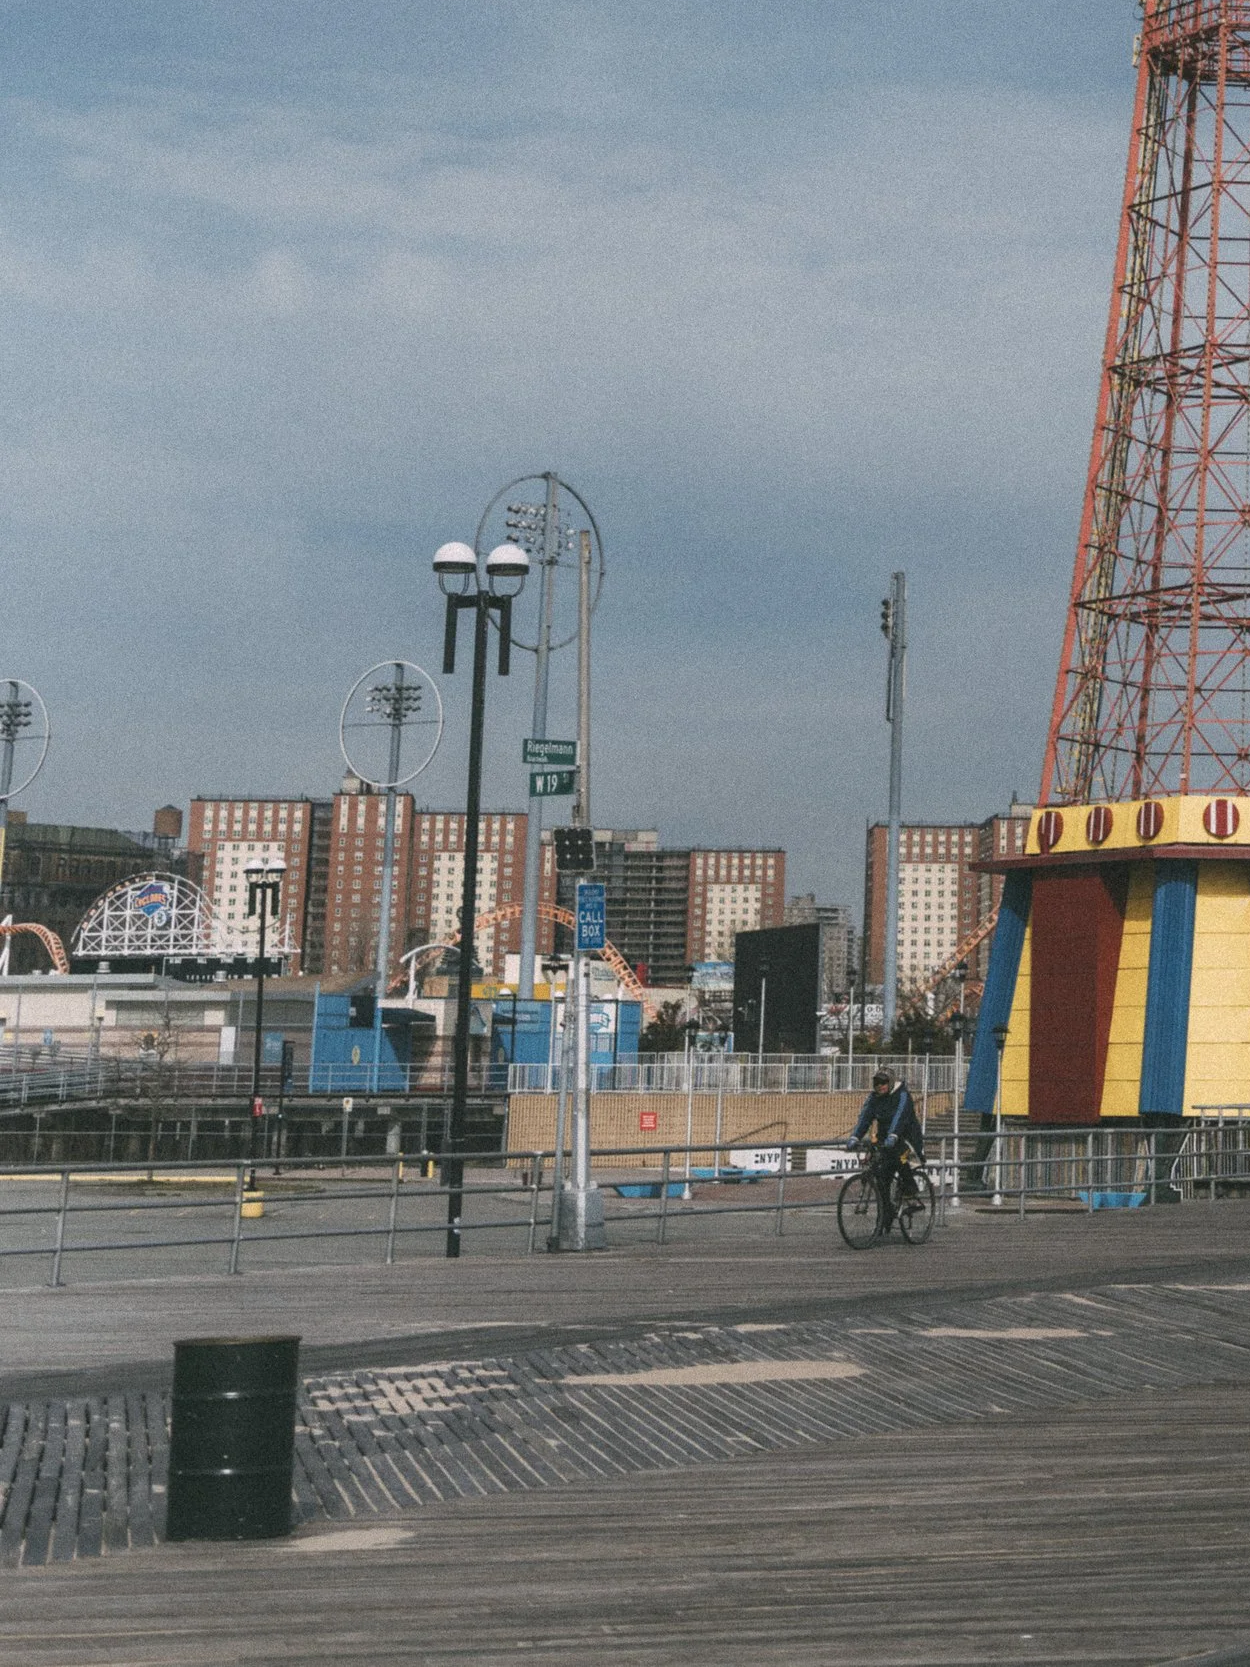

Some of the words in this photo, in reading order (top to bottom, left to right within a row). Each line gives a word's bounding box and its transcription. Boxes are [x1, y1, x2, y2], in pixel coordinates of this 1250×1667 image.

[527, 740, 573, 757] Riegelmann
[535, 775, 545, 793] W
[547, 774, 558, 793] 19
[579, 911, 603, 923] CALL
[582, 925, 601, 937] BOX
[760, 1153, 781, 1163] NYP
[836, 1159, 858, 1170] NYP
